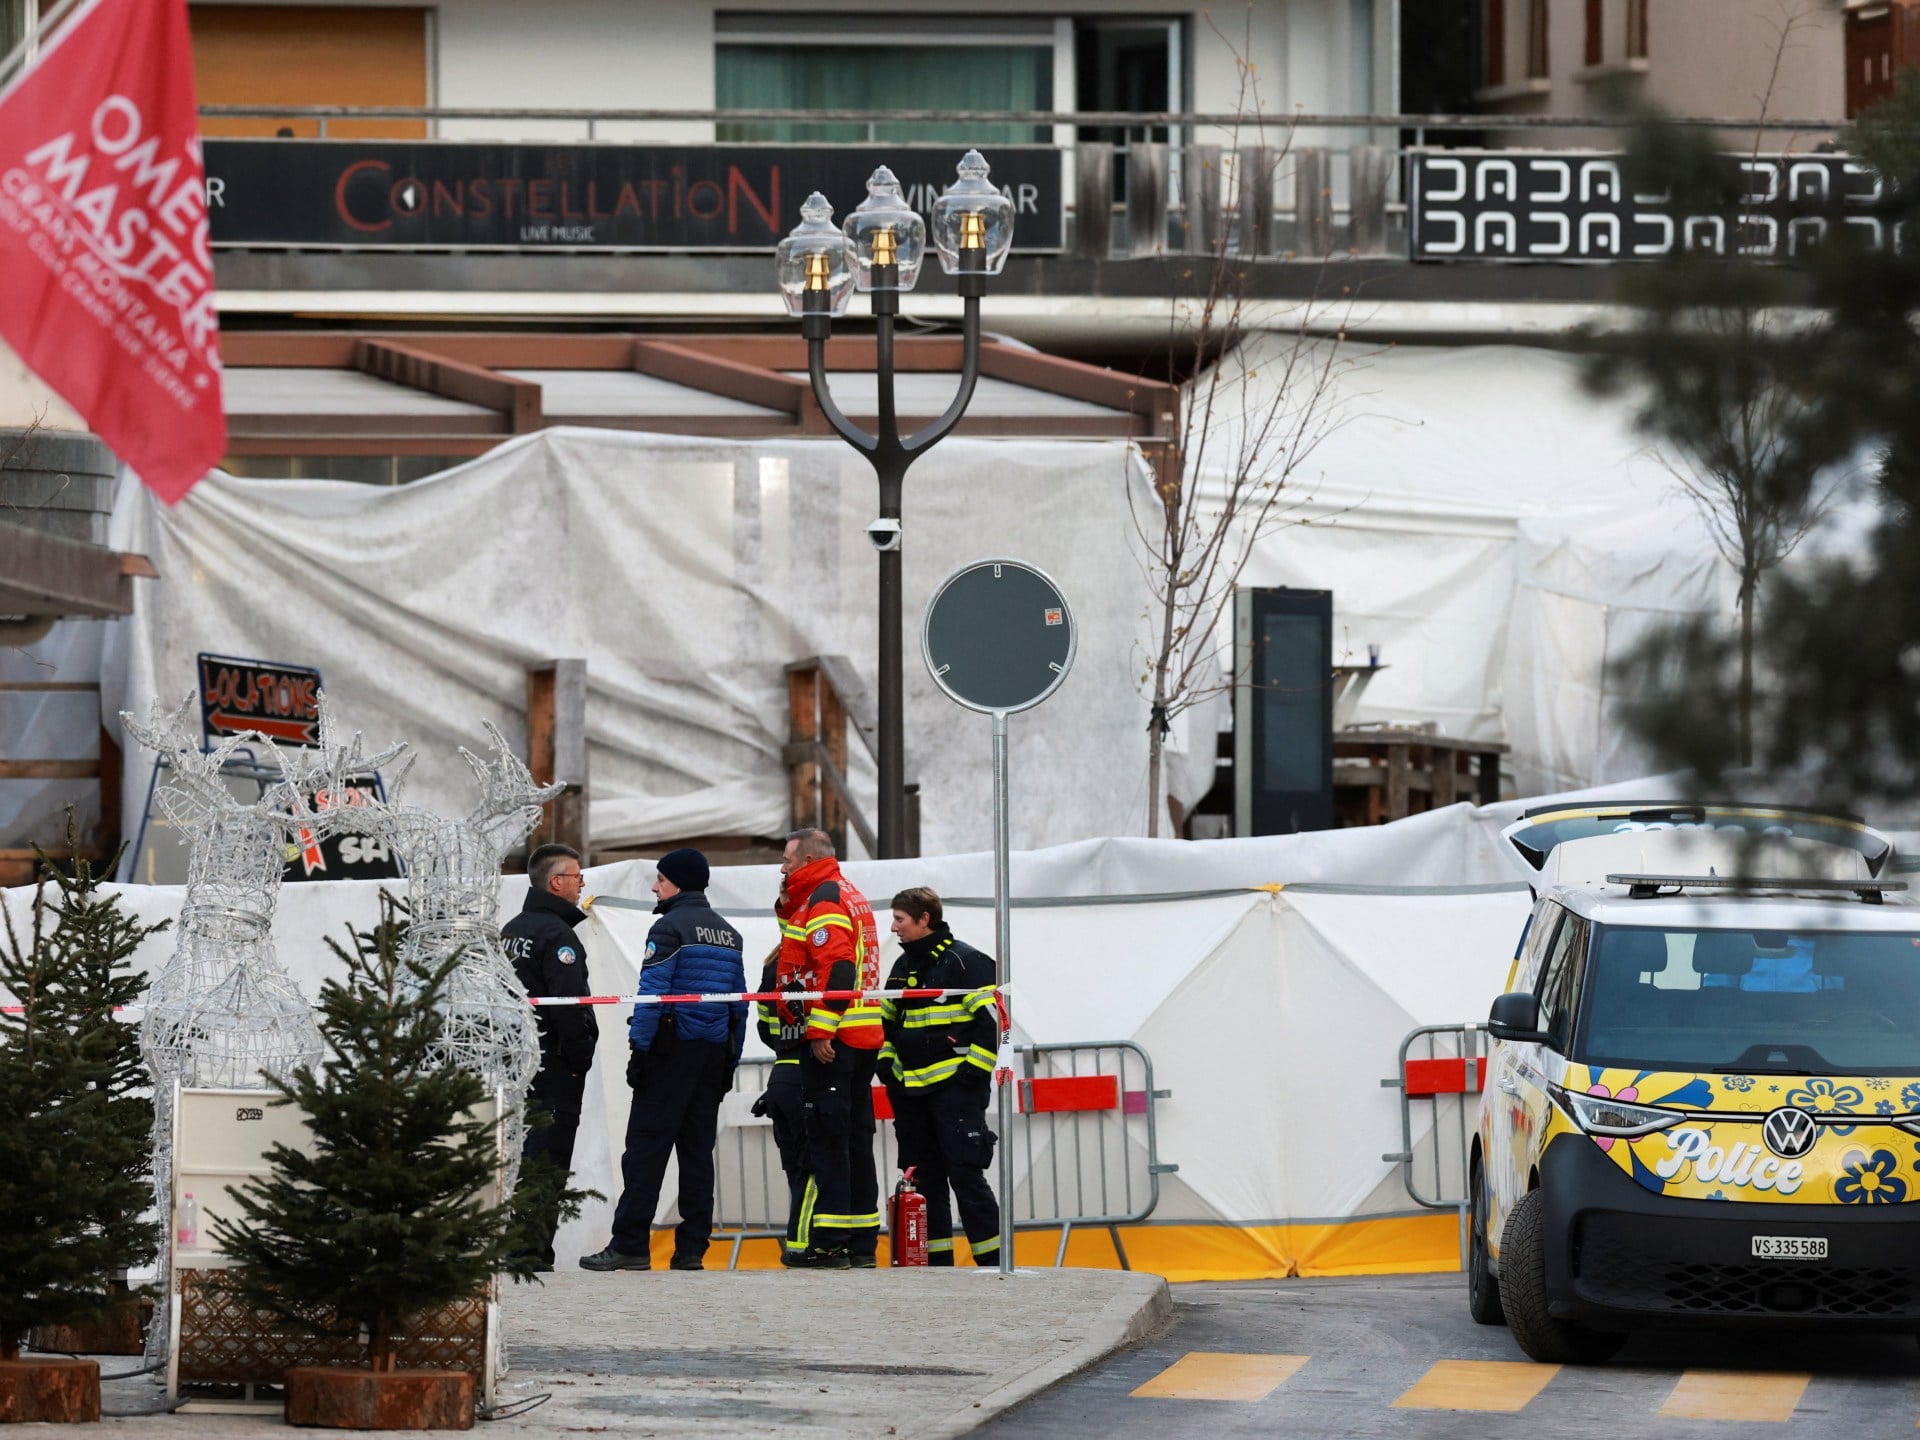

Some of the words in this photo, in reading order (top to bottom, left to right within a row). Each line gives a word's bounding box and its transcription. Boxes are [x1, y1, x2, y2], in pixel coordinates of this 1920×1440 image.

[520, 225, 549, 241] LIVE
[551, 225, 595, 241] MUSIC
[72, 252, 189, 372] MONTANA
[695, 926, 736, 947] POLICE
[1656, 1127, 1805, 1195] Police
